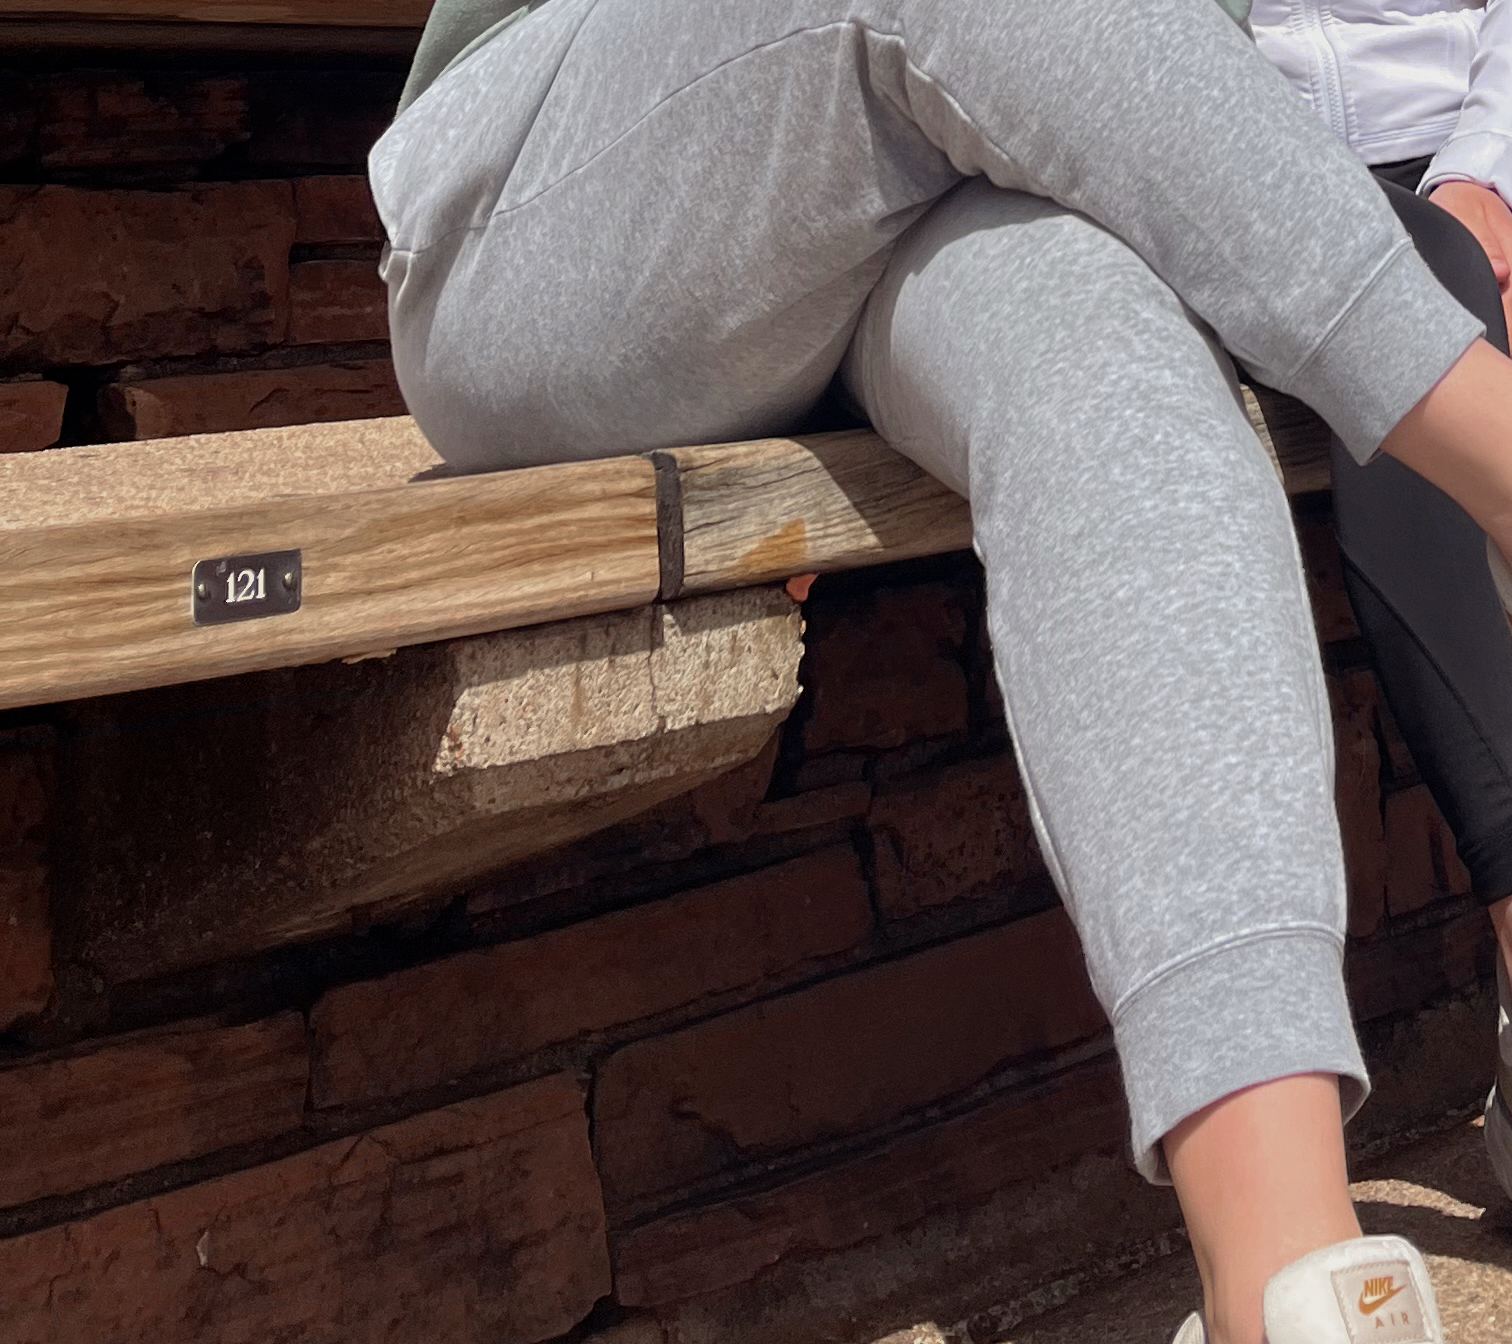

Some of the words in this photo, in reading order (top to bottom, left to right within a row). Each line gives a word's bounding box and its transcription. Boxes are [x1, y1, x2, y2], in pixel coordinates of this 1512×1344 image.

[225, 567, 266, 604] 121
[1363, 1275, 1394, 1299] NIKE
[1375, 1311, 1410, 1330] AIR
